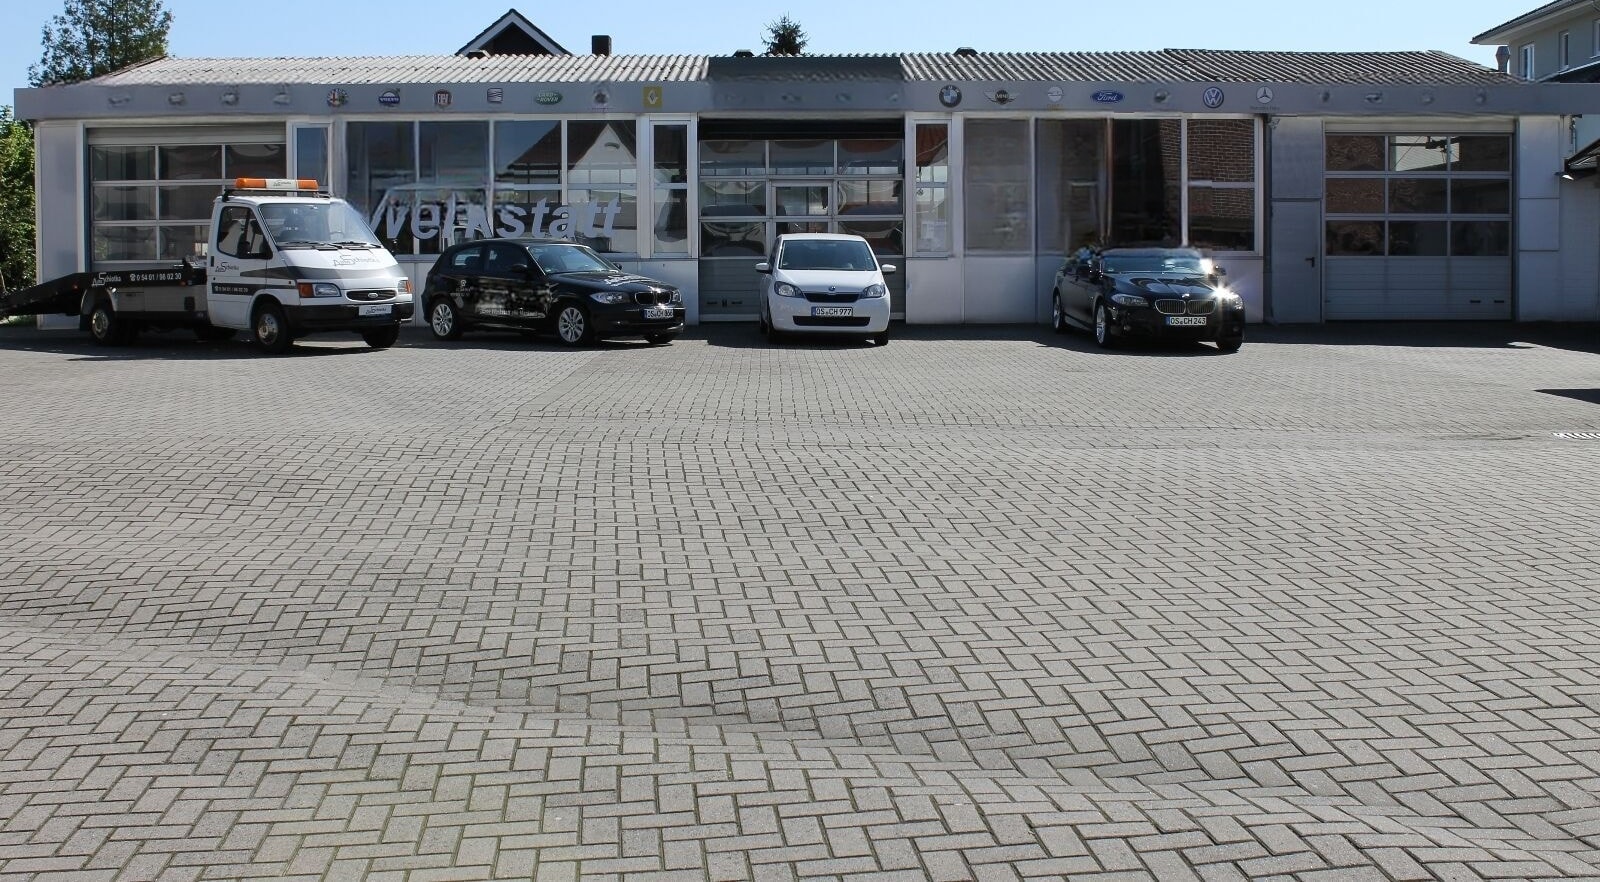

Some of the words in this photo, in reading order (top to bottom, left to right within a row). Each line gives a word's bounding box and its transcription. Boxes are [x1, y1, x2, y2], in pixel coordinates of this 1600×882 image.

[1097, 92, 1118, 102] Ford
[1170, 317, 1180, 325] OS
[1183, 317, 1193, 325] CH
[1193, 317, 1206, 325] 243
